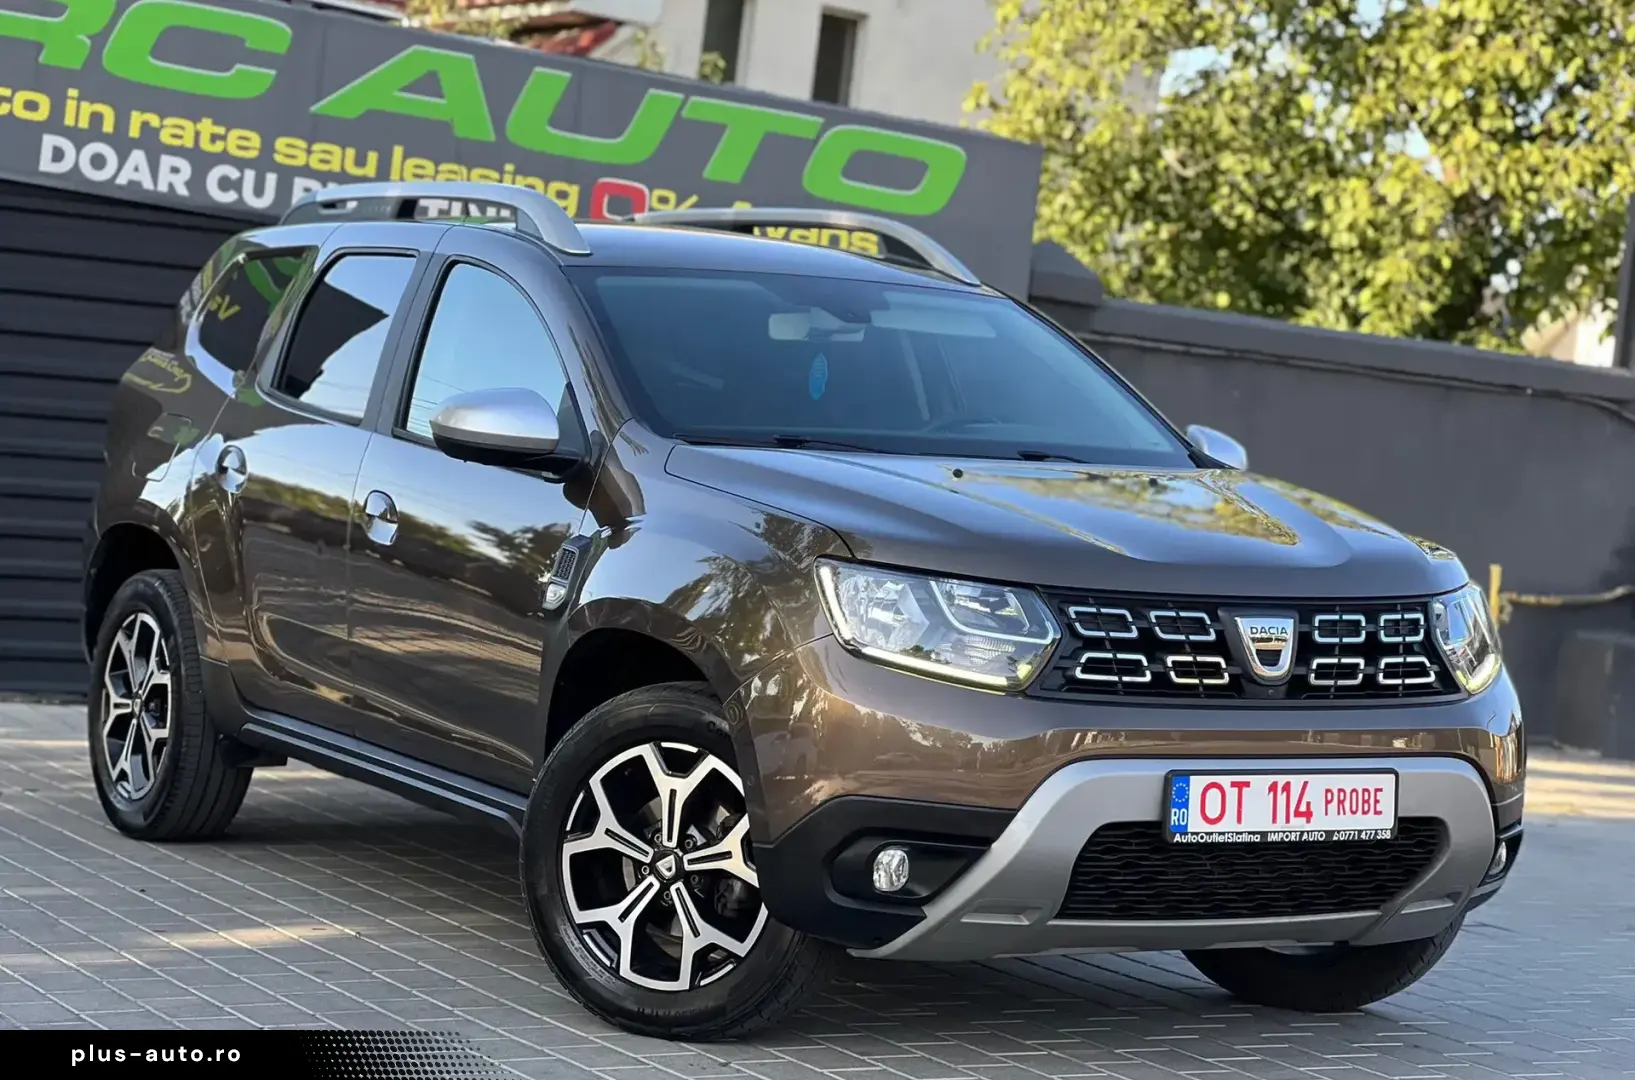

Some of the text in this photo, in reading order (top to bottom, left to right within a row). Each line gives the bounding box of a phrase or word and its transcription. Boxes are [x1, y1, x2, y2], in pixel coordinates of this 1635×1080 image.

[64, 88, 116, 134] in
[128, 109, 262, 159] rate
[273, 136, 379, 182] sau
[389, 144, 581, 218] leasing
[310, 45, 967, 216] AUTO
[38, 132, 193, 197] DOAR
[205, 163, 279, 210] CU
[1250, 626, 1289, 636] DACIA
[1171, 808, 1188, 827] RO
[1200, 780, 1384, 826] OT 114 PROBE
[1173, 829, 1392, 843] AutoOutletSlatina IMPORT AUTO 0771 477 358
